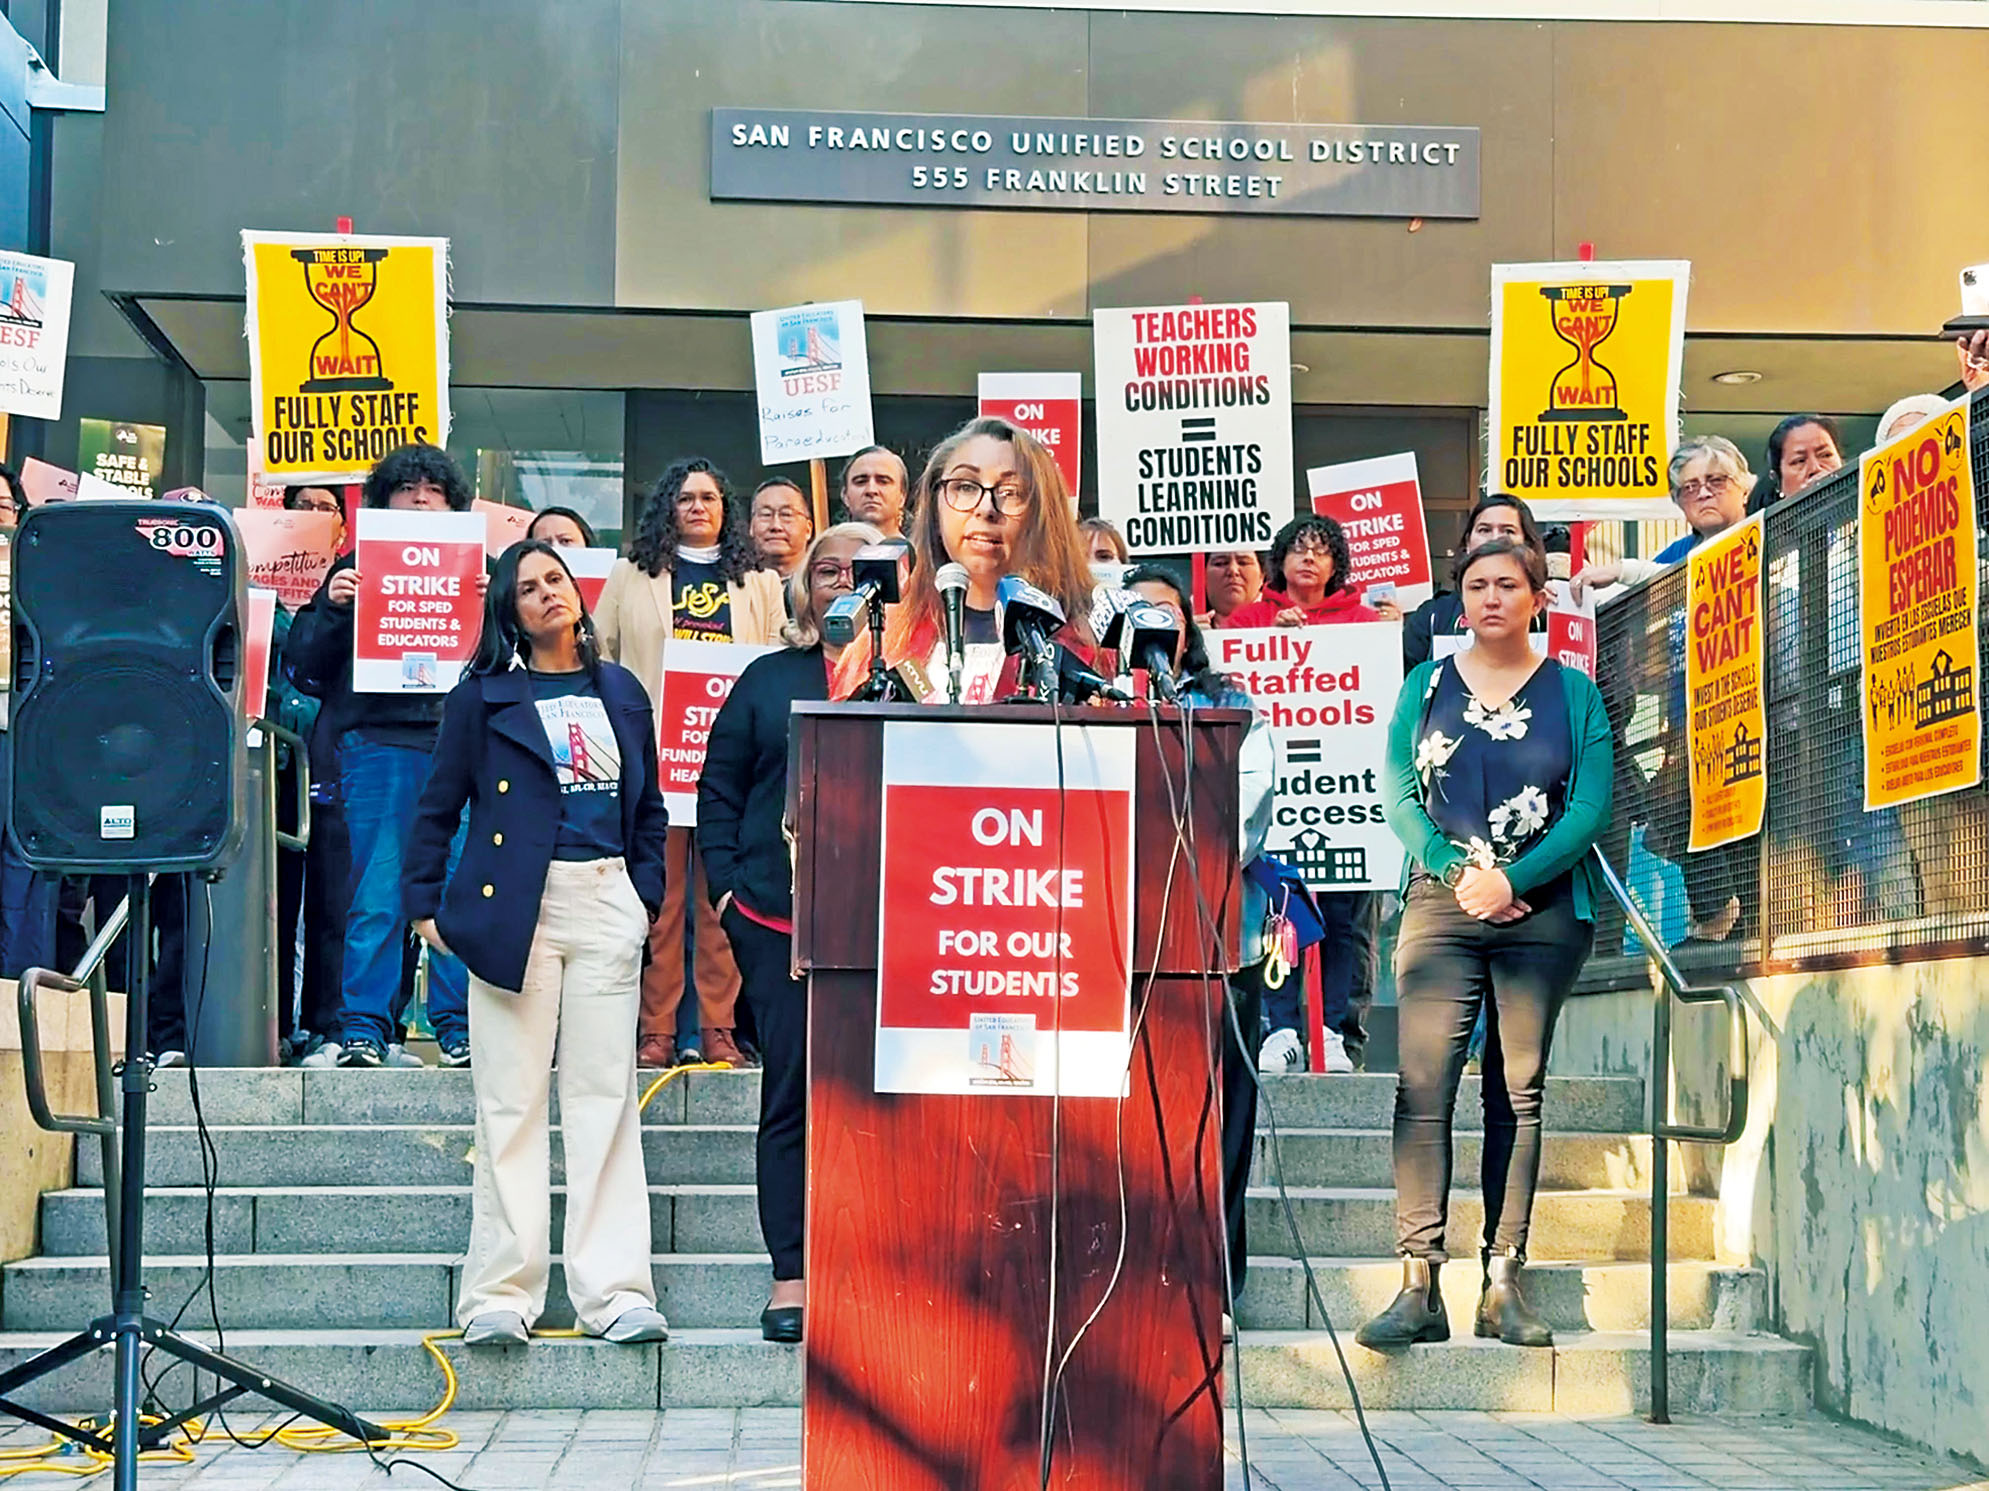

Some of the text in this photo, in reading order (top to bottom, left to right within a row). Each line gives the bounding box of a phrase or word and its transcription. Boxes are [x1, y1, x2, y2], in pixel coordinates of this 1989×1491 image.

[733, 124, 1460, 165] SAN FRANCISCO UNIFIED SCHOOL DISTRICT
[912, 166, 1282, 197] 555 FRANKLIN STREET
[313, 249, 365, 263] TIME IS UP!
[324, 265, 362, 278] WE
[315, 282, 373, 298] CAN'T
[1561, 286, 1609, 299] TIME IS UP!
[1569, 300, 1604, 312] WE
[0, 325, 40, 348] ESF
[1132, 308, 1257, 343] TEACHERS
[1558, 316, 1612, 333] CAN'T
[315, 355, 377, 375] WAIT
[1135, 342, 1250, 377] WORKING
[784, 373, 841, 397] UESF
[1125, 375, 1270, 412] CONDITIONS
[1557, 386, 1615, 404] WAIT
[275, 393, 418, 429] FULLY STAFF
[762, 397, 852, 422] Raises for
[1014, 403, 1044, 420] ON
[268, 426, 428, 464] OUR SCHOOLS
[1513, 424, 1650, 456] FULLY STAFF
[96, 453, 149, 471] SAFE &
[1138, 444, 1262, 479] STUDENTS
[1505, 456, 1658, 488] OUR SCHOOLS
[1893, 438, 1940, 504] NO
[93, 468, 150, 486] STABLE
[1138, 479, 1257, 513] LEARNING
[1350, 490, 1383, 512] ON
[1127, 512, 1272, 548] CONDITIONS
[1341, 513, 1404, 539] STRIKE
[1884, 475, 1959, 562] PODEMOS
[152, 527, 217, 549] 800
[1372, 536, 1400, 550] SPED
[248, 550, 327, 574] ompetitive
[402, 546, 440, 567] ON
[1350, 549, 1410, 568] TUDENTS &
[1708, 544, 1744, 594] WE
[291, 577, 320, 588] AND
[381, 575, 460, 596] STRIKE
[1889, 535, 1957, 615] ESPERAR
[388, 600, 453, 613] FOR SPED
[1694, 573, 1758, 638] CAN'T
[379, 617, 461, 631] STUDENTS &
[1568, 621, 1582, 642] ON
[378, 634, 458, 648] EDUCATORS
[1223, 635, 1313, 667] Fully
[1696, 616, 1754, 674] WAIT
[903, 660, 929, 696] KTVU
[1229, 666, 1360, 695] Staffed
[1259, 699, 1375, 727] hools
[661, 748, 707, 764] FUNDI
[670, 768, 700, 783] HEA
[1273, 768, 1376, 796] udent
[971, 807, 1042, 847] ON
[1276, 804, 1386, 826] ccess
[930, 867, 1083, 908] STRIKE
[939, 930, 1073, 958] FOR OUR
[930, 970, 1079, 997] STUDENTS
